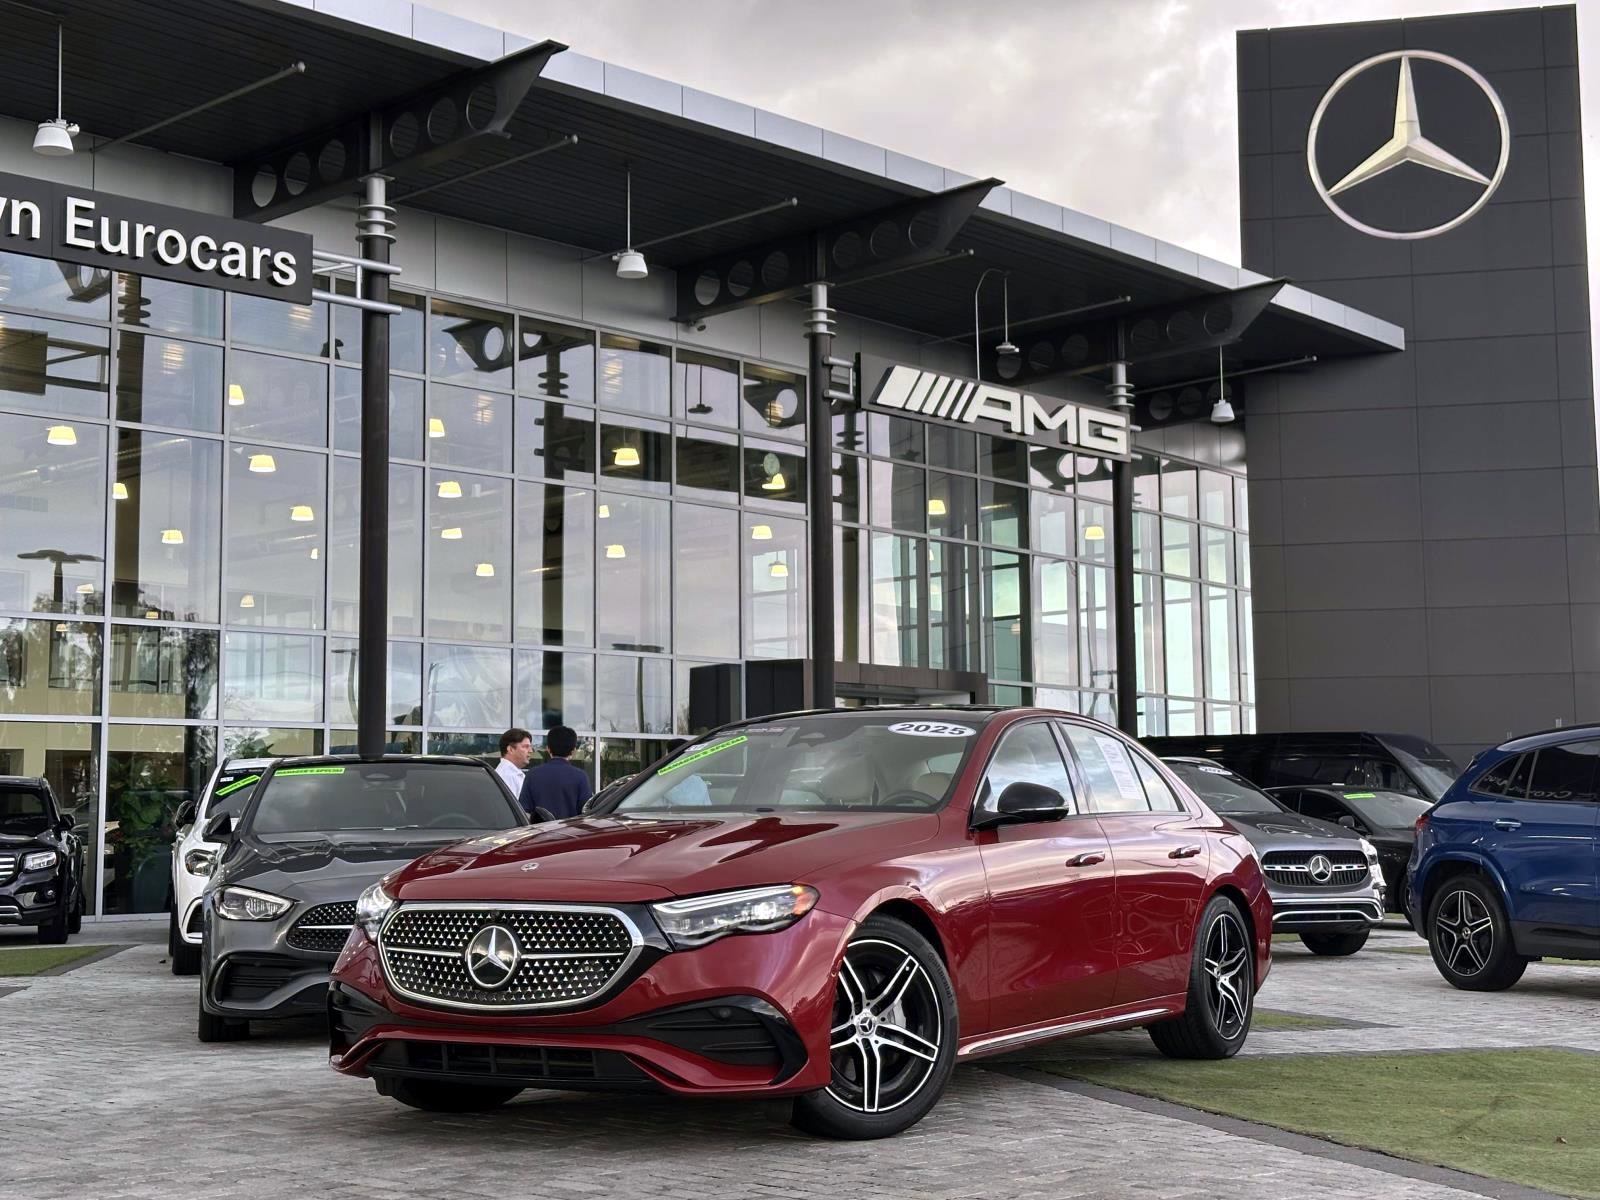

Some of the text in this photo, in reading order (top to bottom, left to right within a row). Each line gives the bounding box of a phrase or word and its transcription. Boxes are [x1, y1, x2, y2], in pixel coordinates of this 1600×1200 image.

[0, 195, 297, 286] n Eurocars
[962, 383, 1128, 456] AMG
[896, 723, 967, 735] 2025
